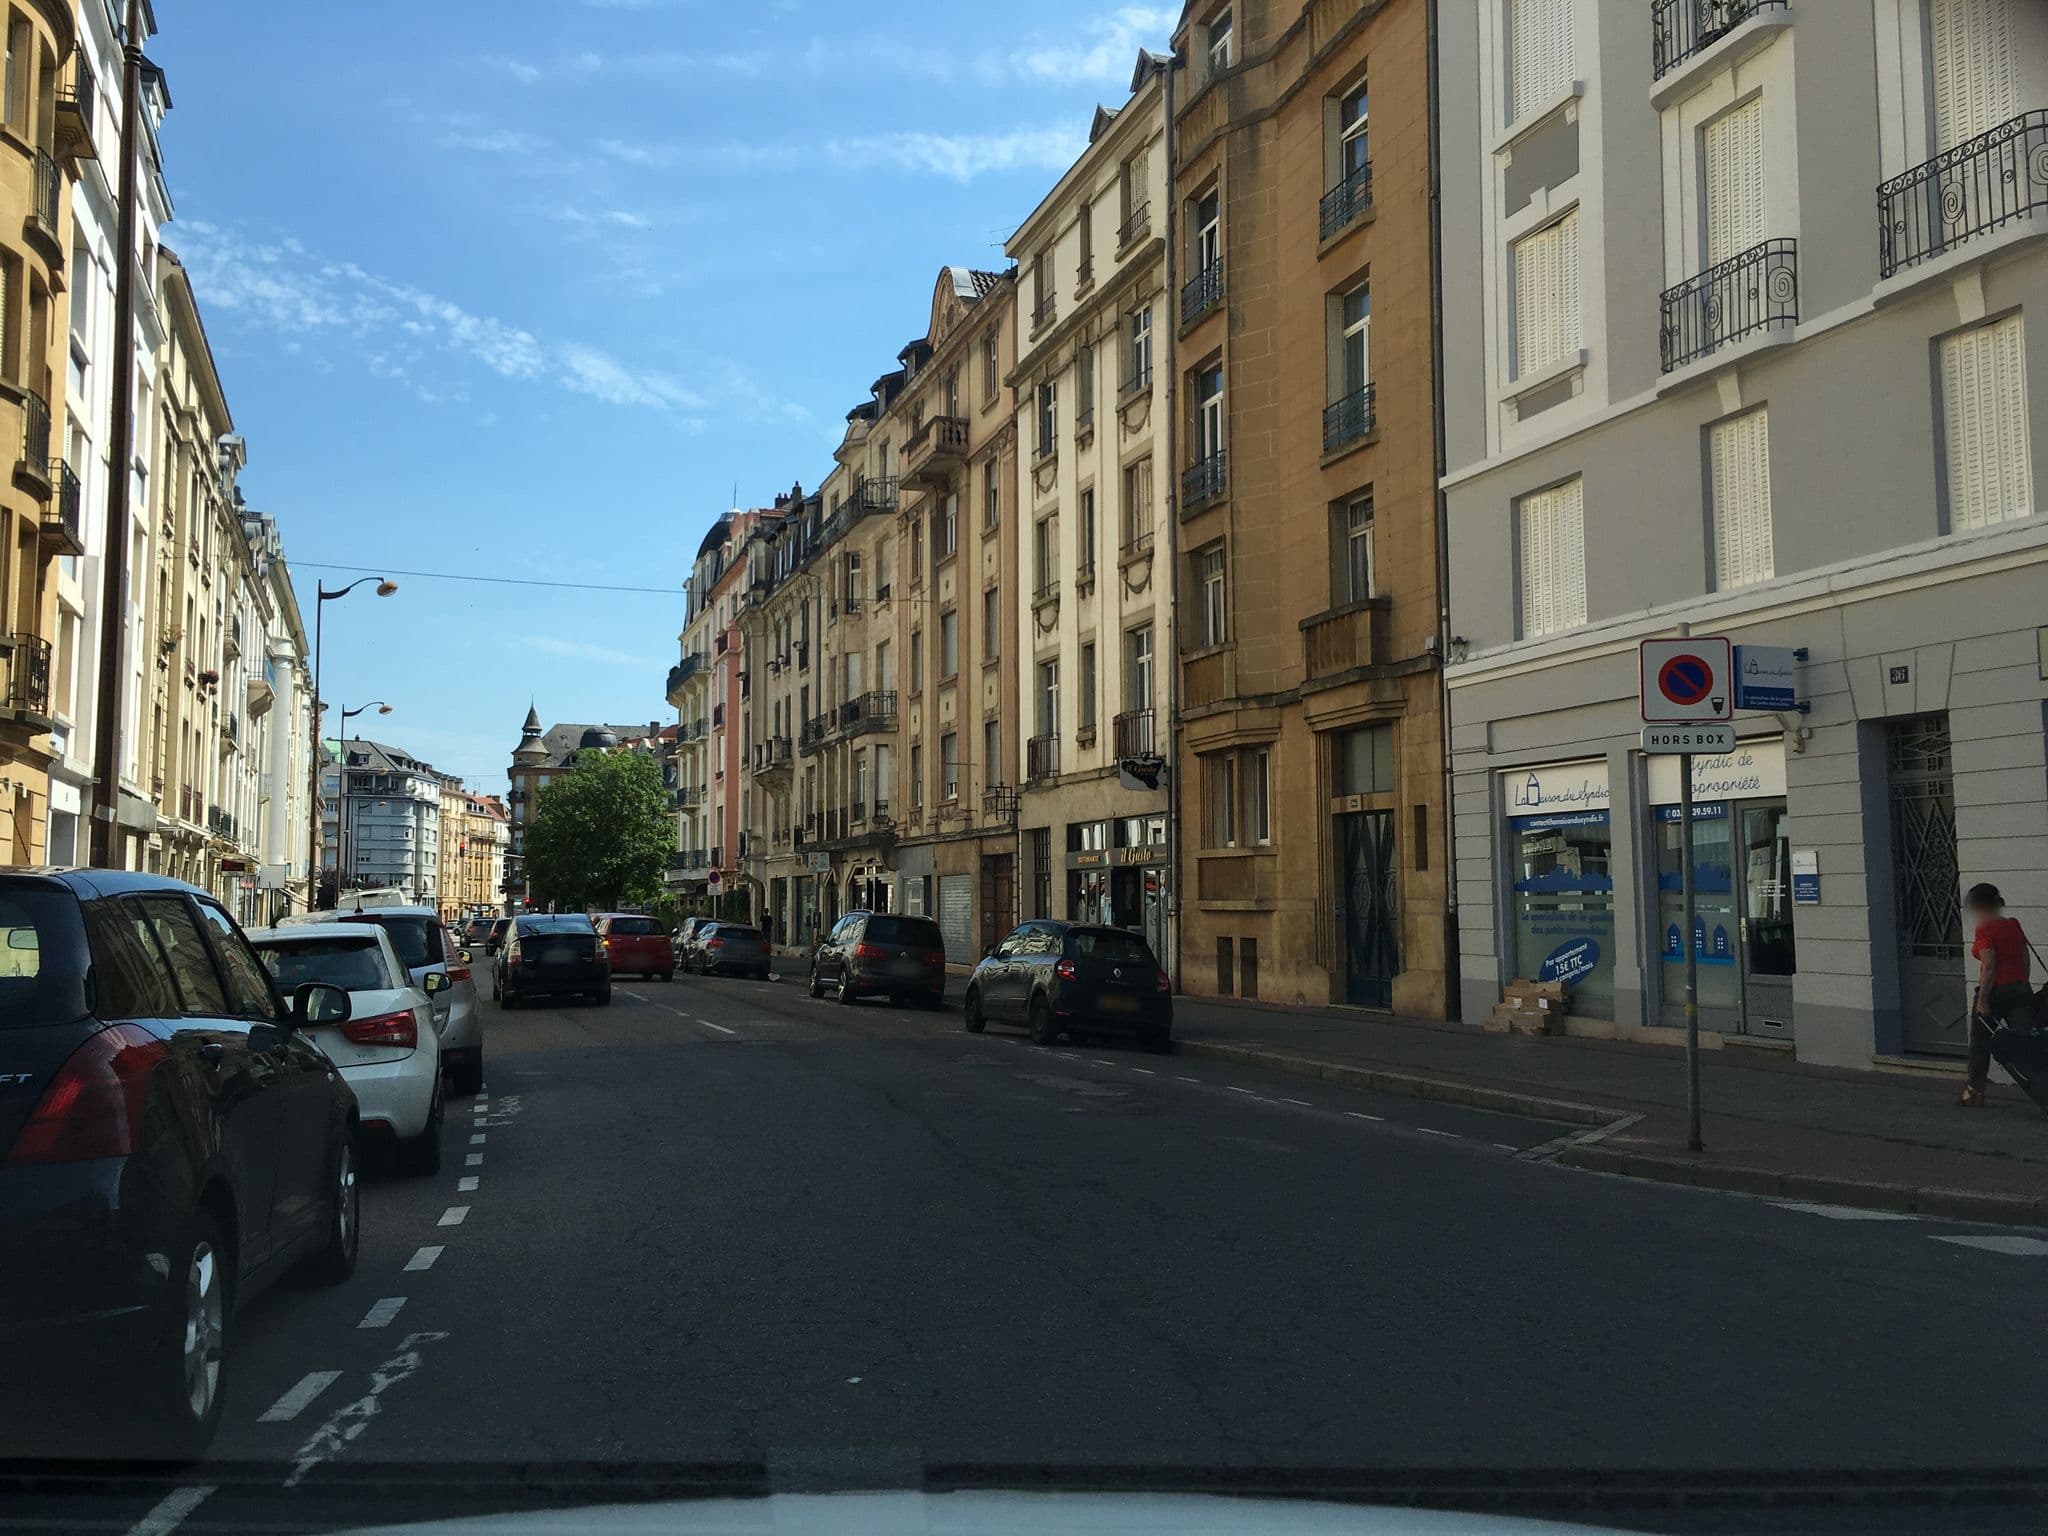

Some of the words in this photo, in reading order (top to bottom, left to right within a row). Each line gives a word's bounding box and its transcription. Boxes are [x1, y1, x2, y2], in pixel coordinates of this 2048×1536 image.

[1652, 734, 1691, 745] HORS
[1696, 733, 1725, 745] BOX
[1737, 748, 1753, 767] de
[1691, 775, 1760, 800] opropriété
[1128, 847, 1152, 865] Gusto
[1555, 960, 1569, 975] 15€
[1569, 954, 1583, 969] TTC
